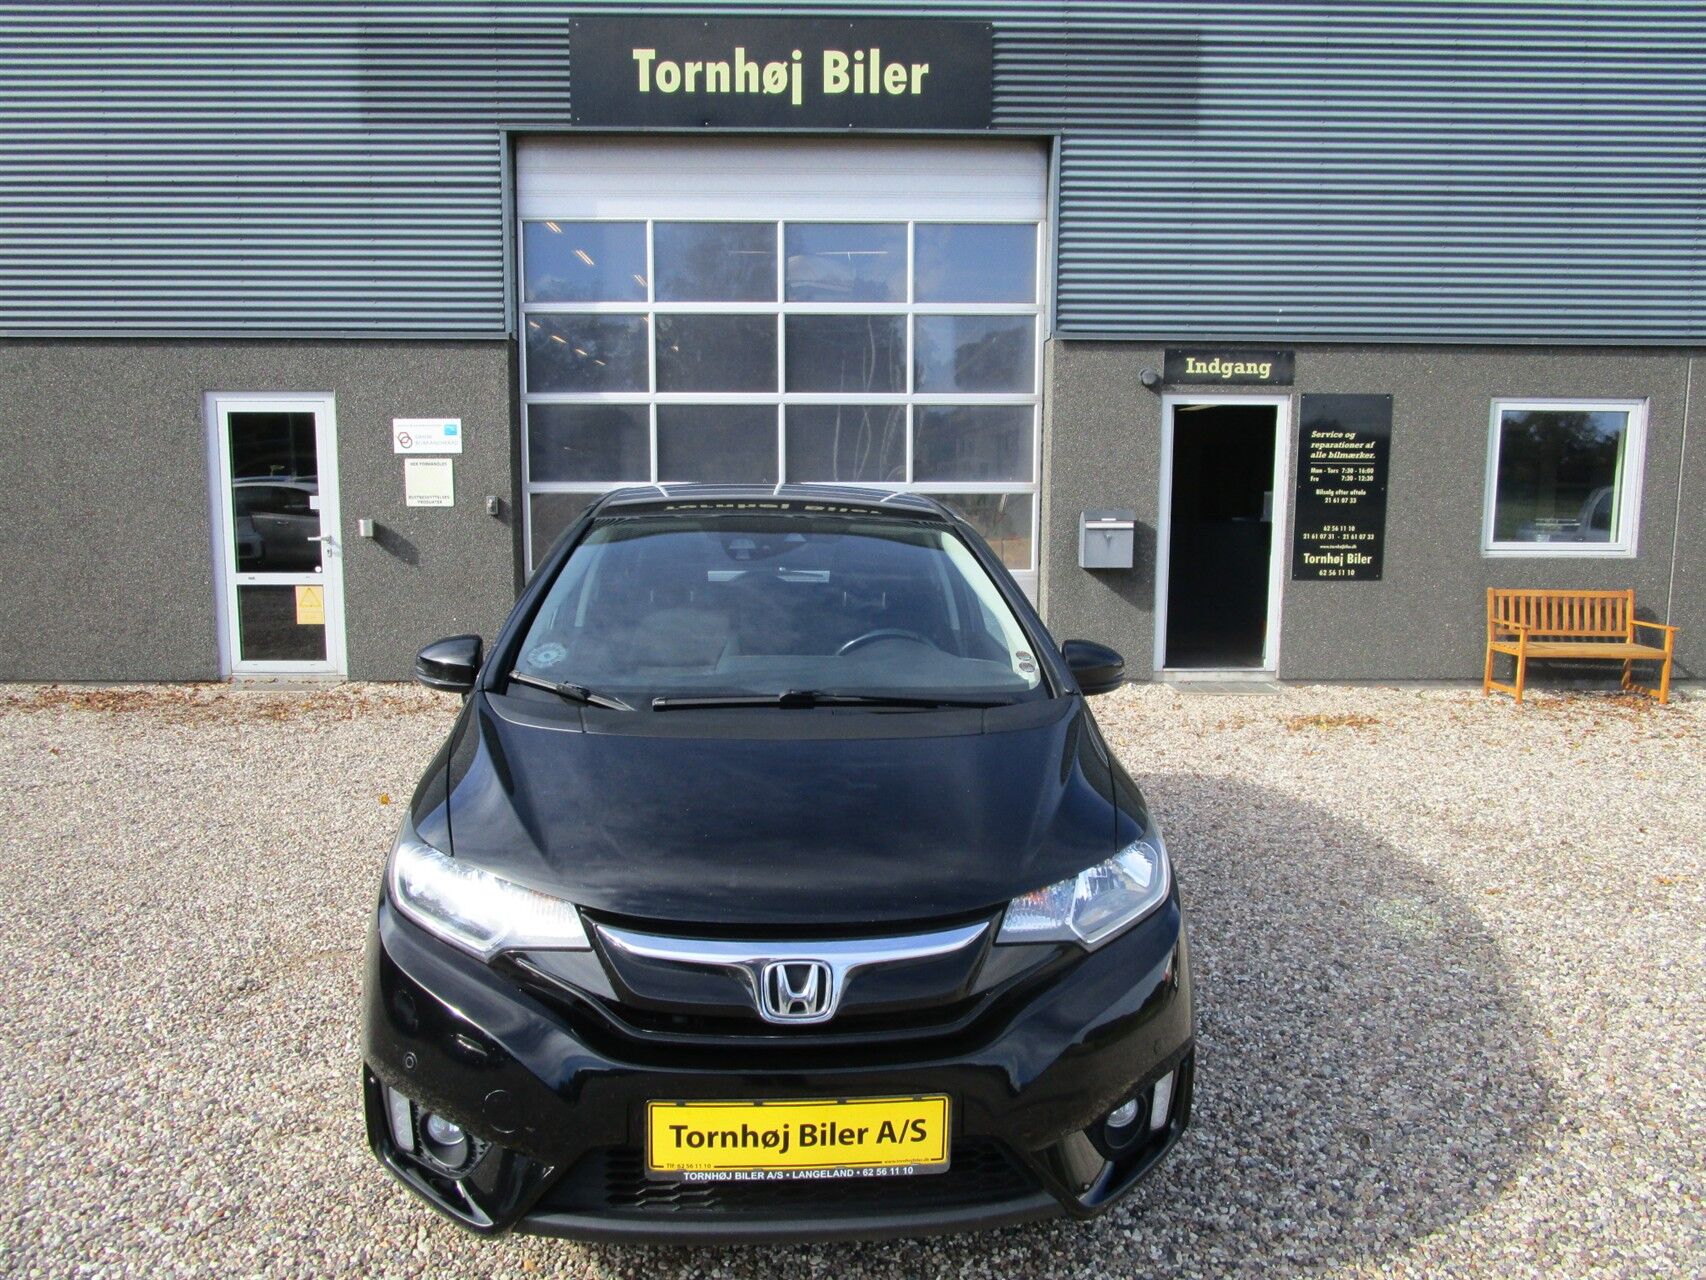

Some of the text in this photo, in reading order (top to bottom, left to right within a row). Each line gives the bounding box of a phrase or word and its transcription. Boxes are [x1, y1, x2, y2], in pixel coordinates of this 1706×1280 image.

[633, 47, 929, 105] Tornhøj Biler
[1186, 357, 1272, 379] Indgang
[1311, 430, 1356, 440] Service og
[1310, 441, 1376, 450] reparationer af
[1310, 451, 1376, 459] alle bilmærker.
[1303, 552, 1373, 567] Tornhøj Biler
[669, 1118, 928, 1154] Tornhøj Biler A/S
[684, 1166, 914, 1180] TORNHØJ BILER A/S LANGELAND 62 56 11 10
